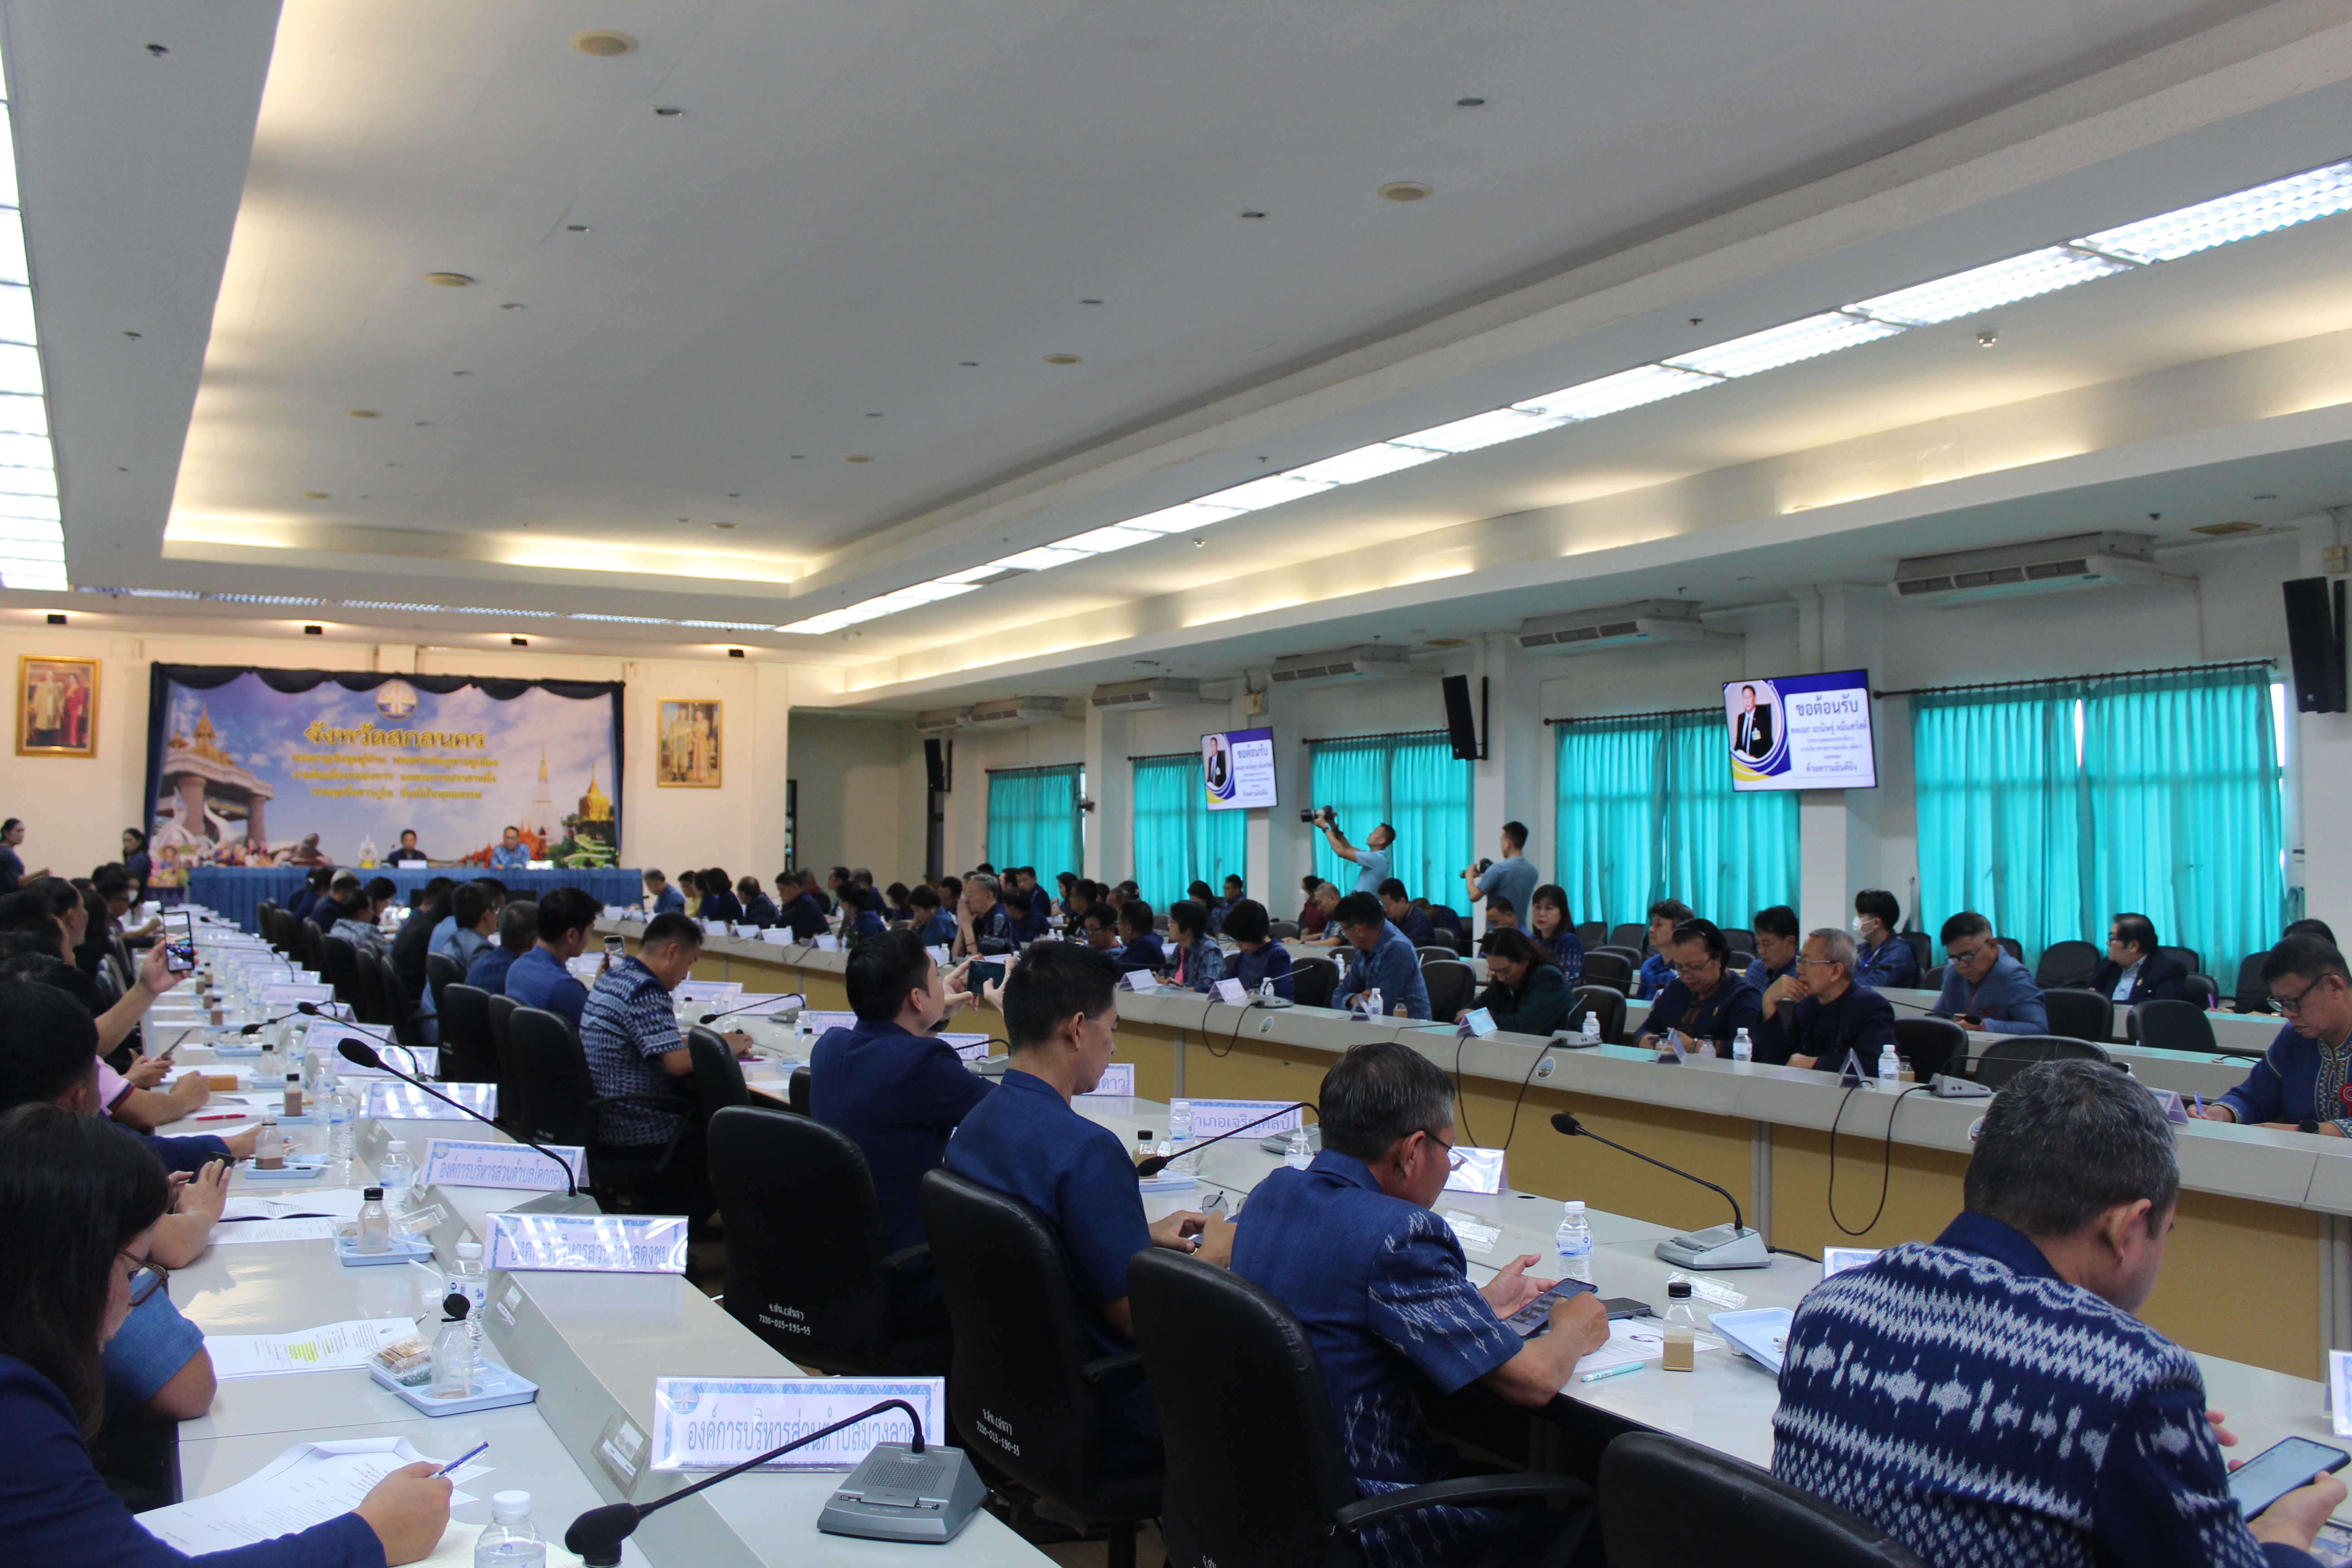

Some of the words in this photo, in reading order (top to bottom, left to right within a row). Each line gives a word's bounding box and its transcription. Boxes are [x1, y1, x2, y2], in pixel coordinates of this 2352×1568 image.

[1795, 693, 1858, 716] ขอต้อนรับ
[304, 720, 486, 749] จังหวัดสกลนคร
[1191, 1112, 1290, 1134] ำเภอเจริญศิลป์
[688, 1403, 914, 1451] องค์การบริหารส่วนตำบลมวงลาย
